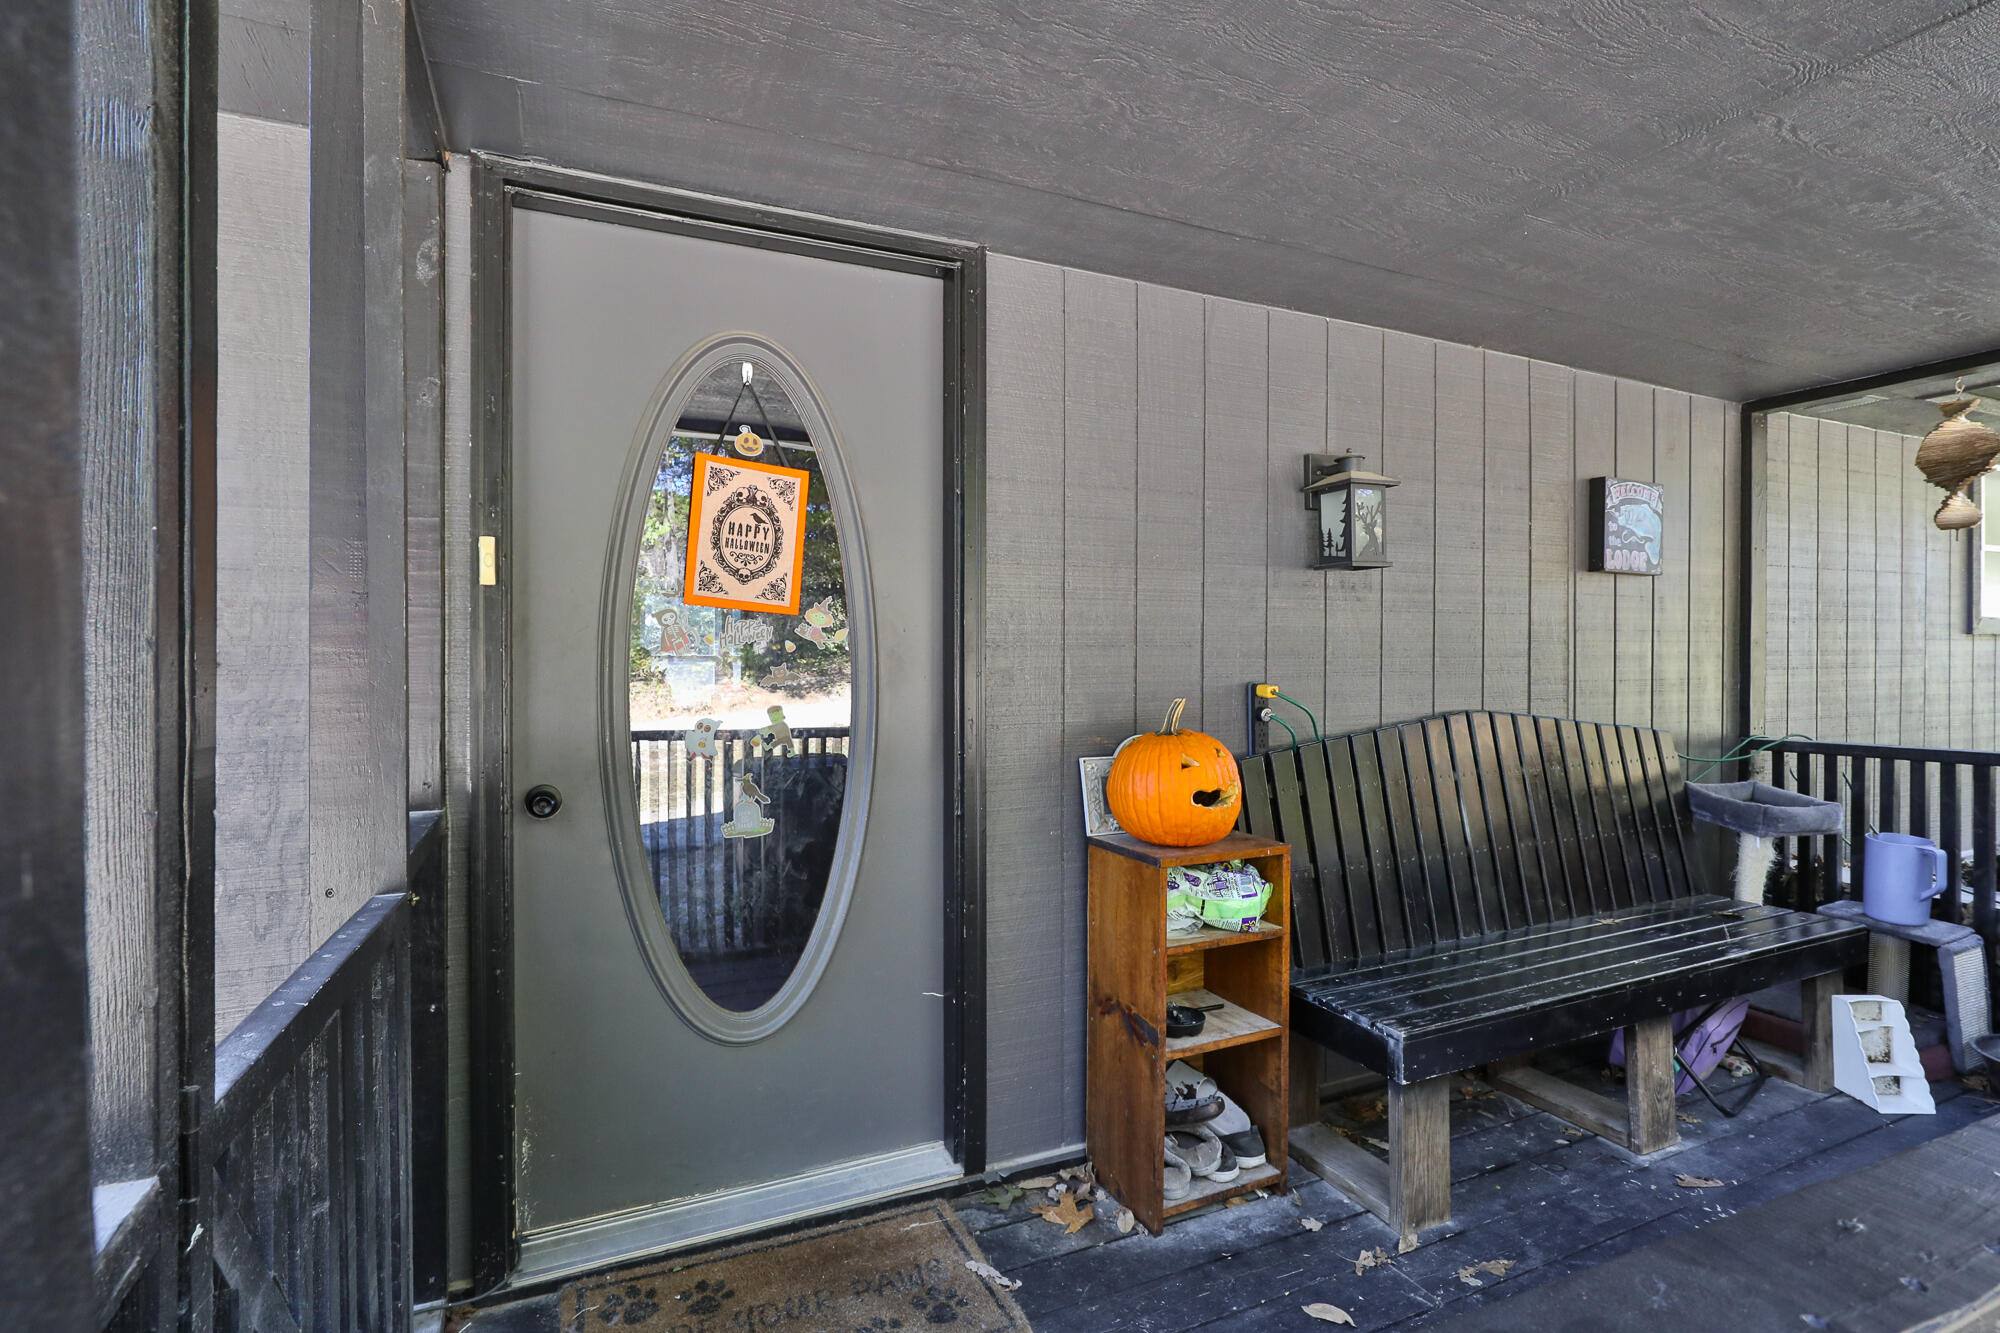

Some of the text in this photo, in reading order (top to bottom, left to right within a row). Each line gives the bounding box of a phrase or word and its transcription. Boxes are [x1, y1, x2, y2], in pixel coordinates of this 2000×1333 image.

[1613, 485, 1656, 502] WELCOME
[728, 521, 769, 540] HAPPY
[725, 537, 769, 555] HALLOWEEN
